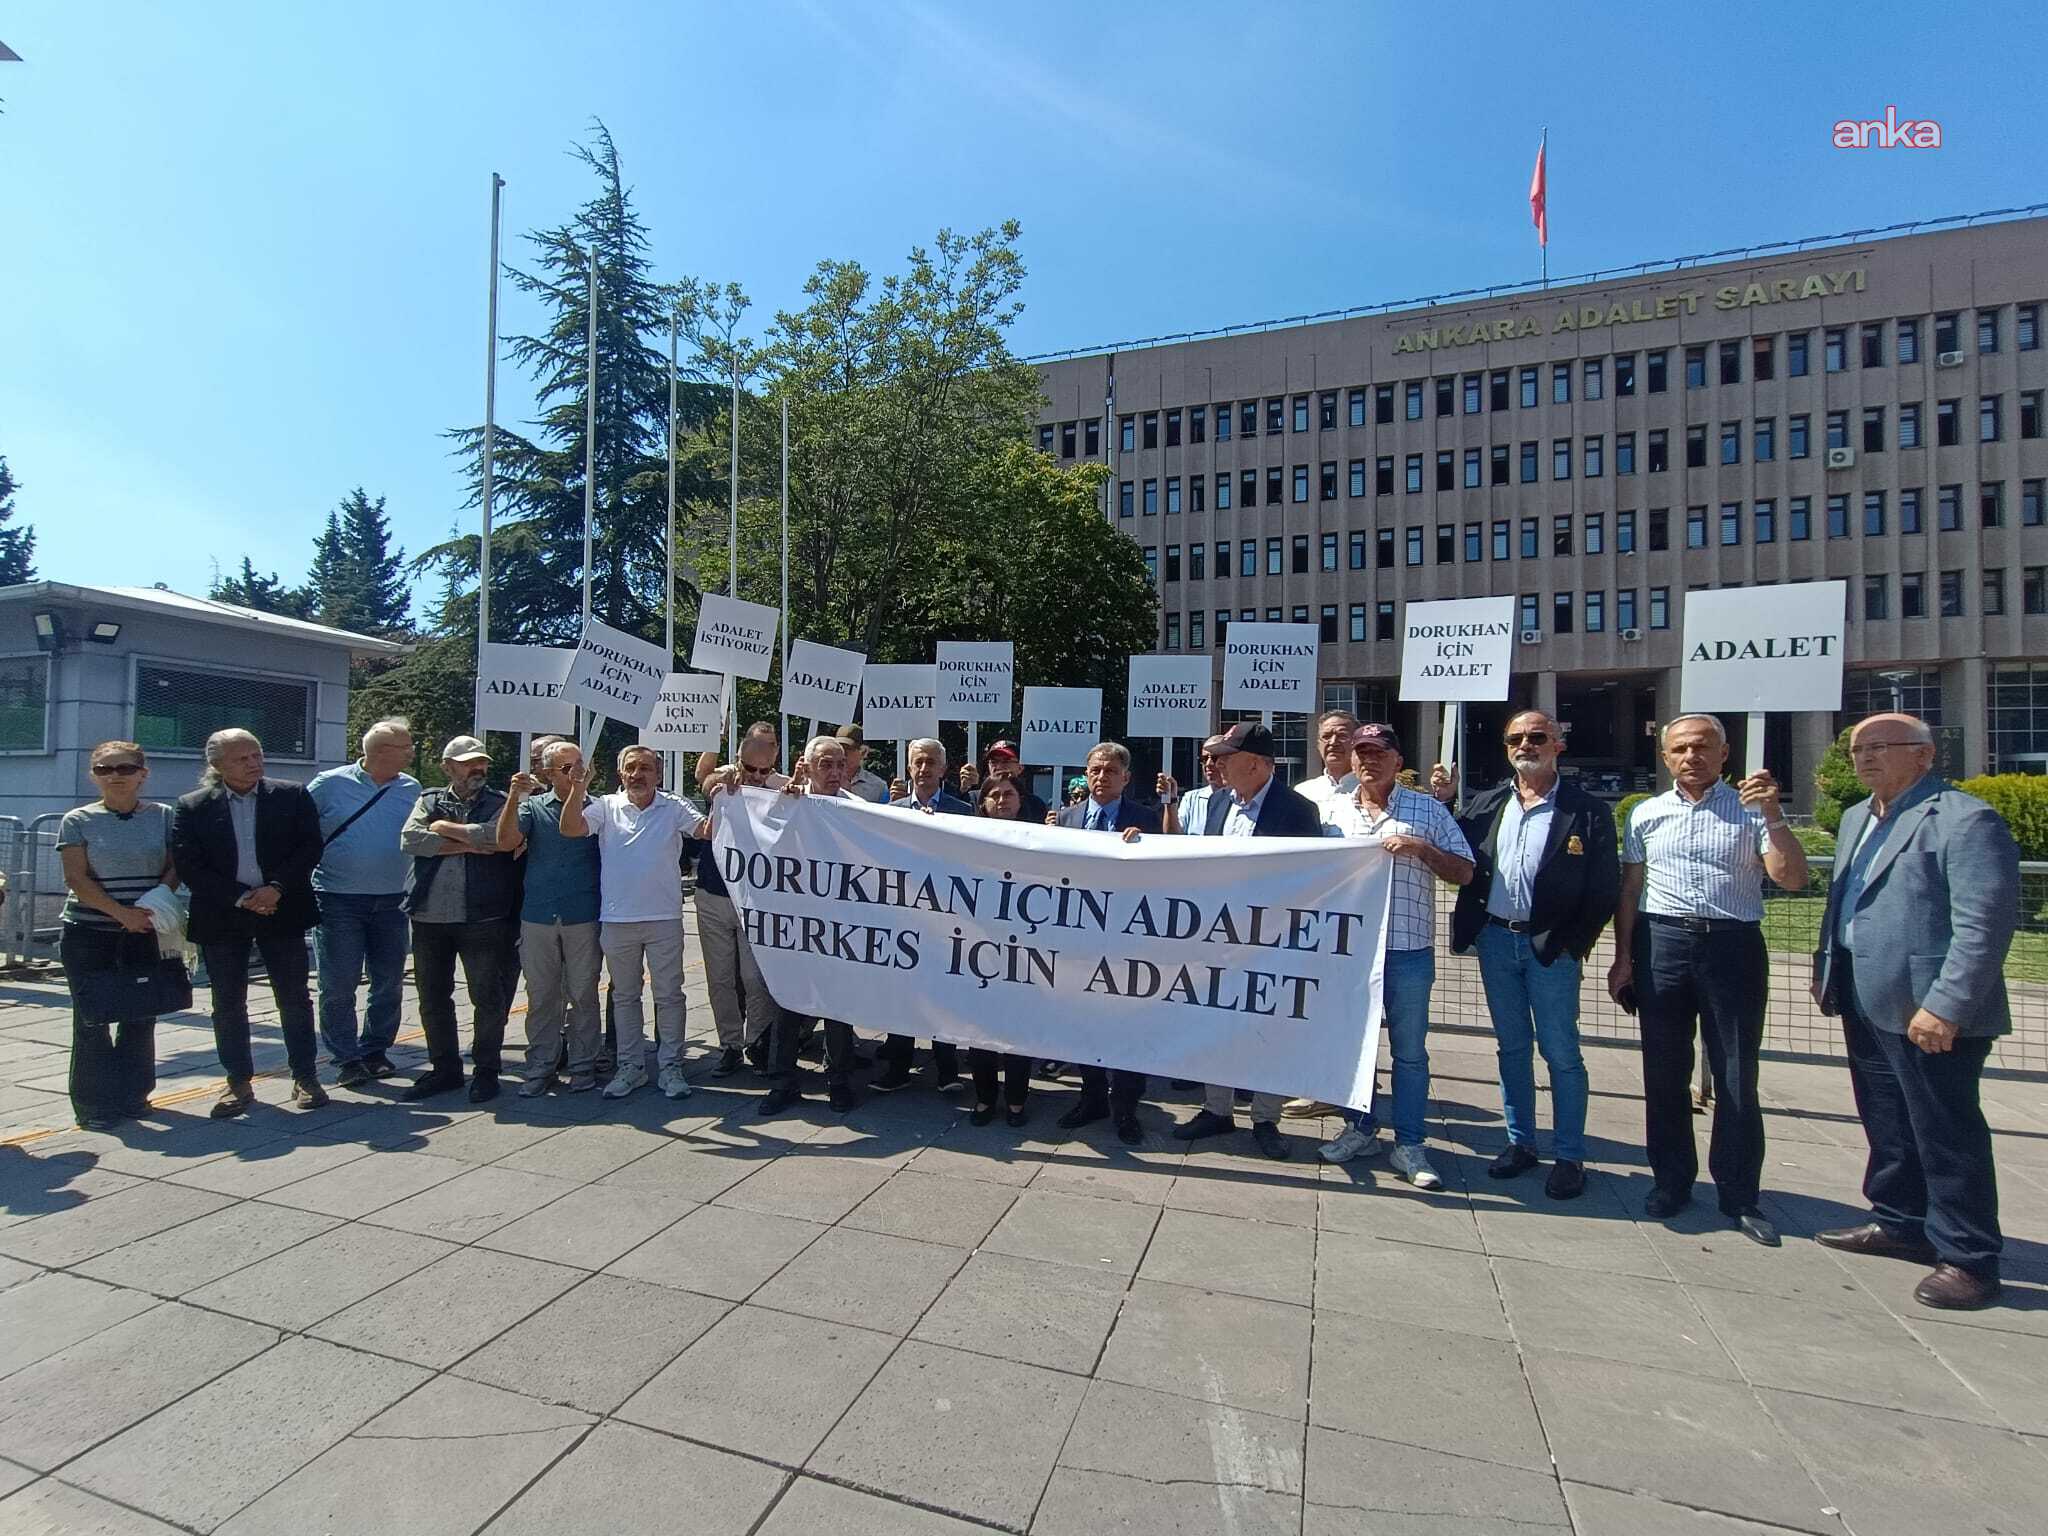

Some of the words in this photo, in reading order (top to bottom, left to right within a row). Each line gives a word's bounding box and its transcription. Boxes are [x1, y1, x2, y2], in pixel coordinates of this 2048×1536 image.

[1392, 315, 1541, 355] ANKARA
[1552, 288, 1705, 333] ADALET
[1715, 268, 1868, 311] SARAYI
[710, 622, 764, 640] ADALET
[1408, 622, 1510, 639] DORUKHAN
[700, 631, 770, 656] İSTİYORUZ
[1227, 643, 1315, 657] DORUKHAN
[1436, 640, 1474, 660] İÇİN
[1689, 634, 1837, 662] ADALET
[581, 639, 665, 680] DORUKHAN
[939, 660, 1012, 674] DORUKHAN
[1252, 658, 1286, 675] İÇİN
[600, 662, 633, 684] İÇİN
[1420, 662, 1493, 678] ADALET
[485, 680, 565, 698] ADALE
[788, 671, 858, 697] ADALET
[959, 674, 988, 689] İÇİN
[1142, 683, 1198, 695] ADALET
[1239, 678, 1301, 691] ADALET
[580, 677, 642, 705] ADALET
[949, 692, 1001, 704] ADALET
[866, 695, 936, 710] ADALET
[1133, 695, 1208, 709] İSTİYORUZ
[666, 705, 694, 719] İÇİN
[654, 723, 709, 734] ADALET
[1025, 719, 1098, 734] ADALET
[724, 846, 984, 918] DORUKHAN
[998, 870, 1113, 934] İÇİN
[1121, 896, 1364, 957] ADALET
[741, 906, 921, 971] HERKES
[945, 926, 1060, 990] İÇİN
[1084, 955, 1320, 1021] ADALET
